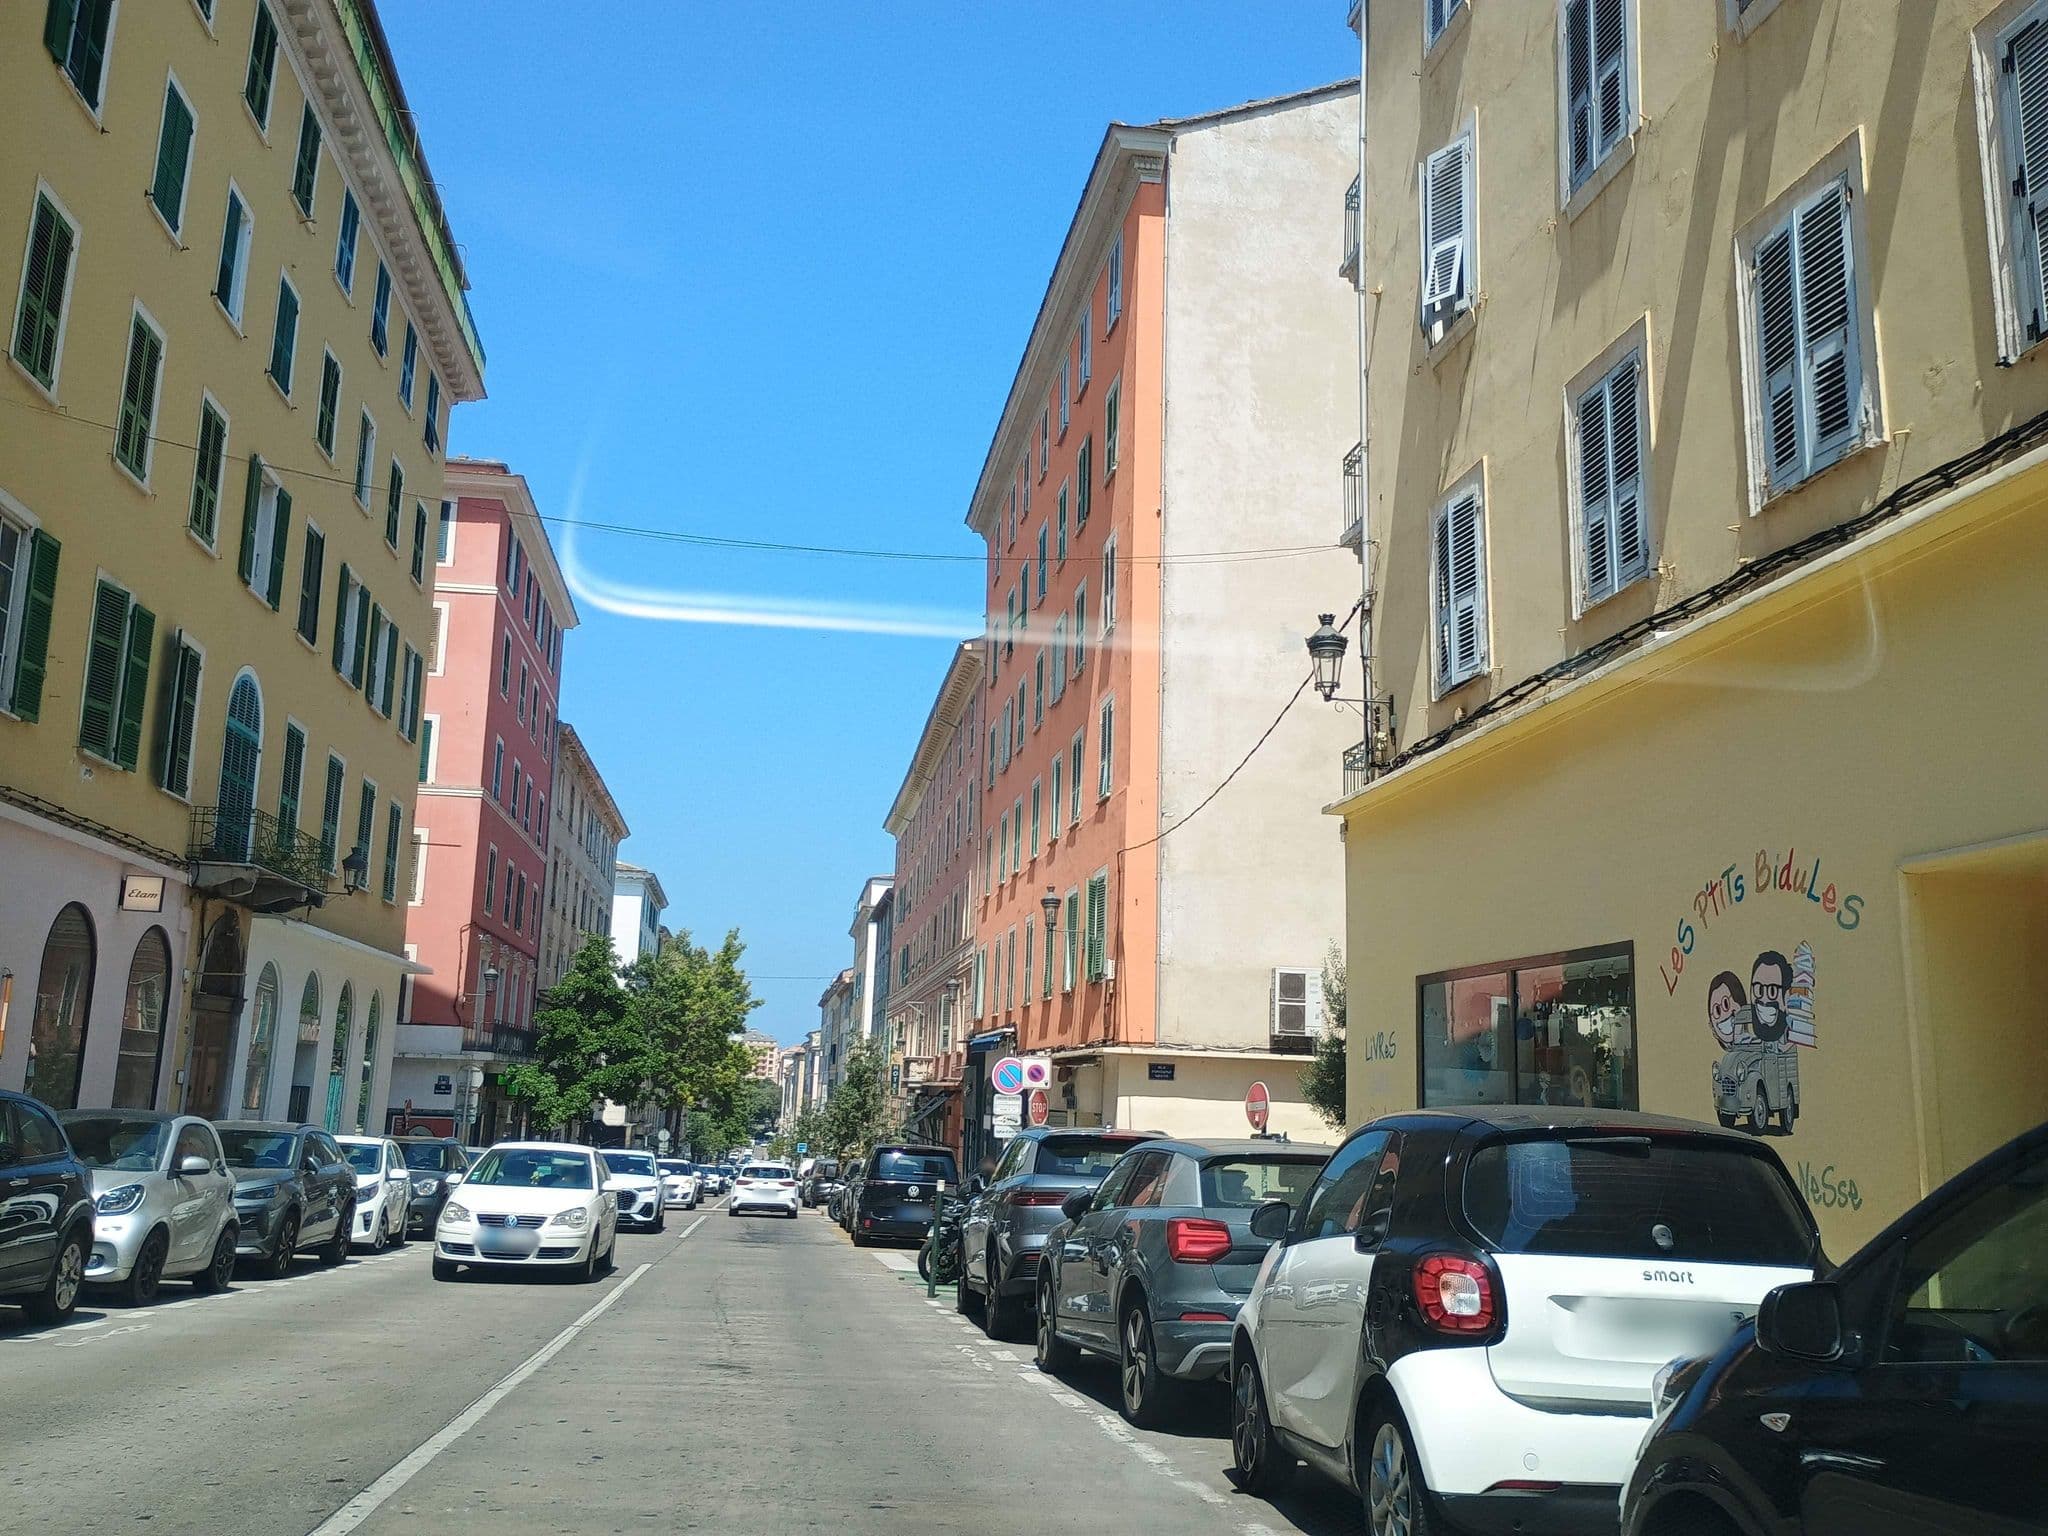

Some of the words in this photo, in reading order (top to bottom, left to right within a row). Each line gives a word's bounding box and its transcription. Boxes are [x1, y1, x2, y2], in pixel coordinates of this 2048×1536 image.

[891, 1064, 899, 1095] HOTEL
[1032, 1102, 1047, 1113] STOP
[1642, 1267, 1695, 1285] smart
